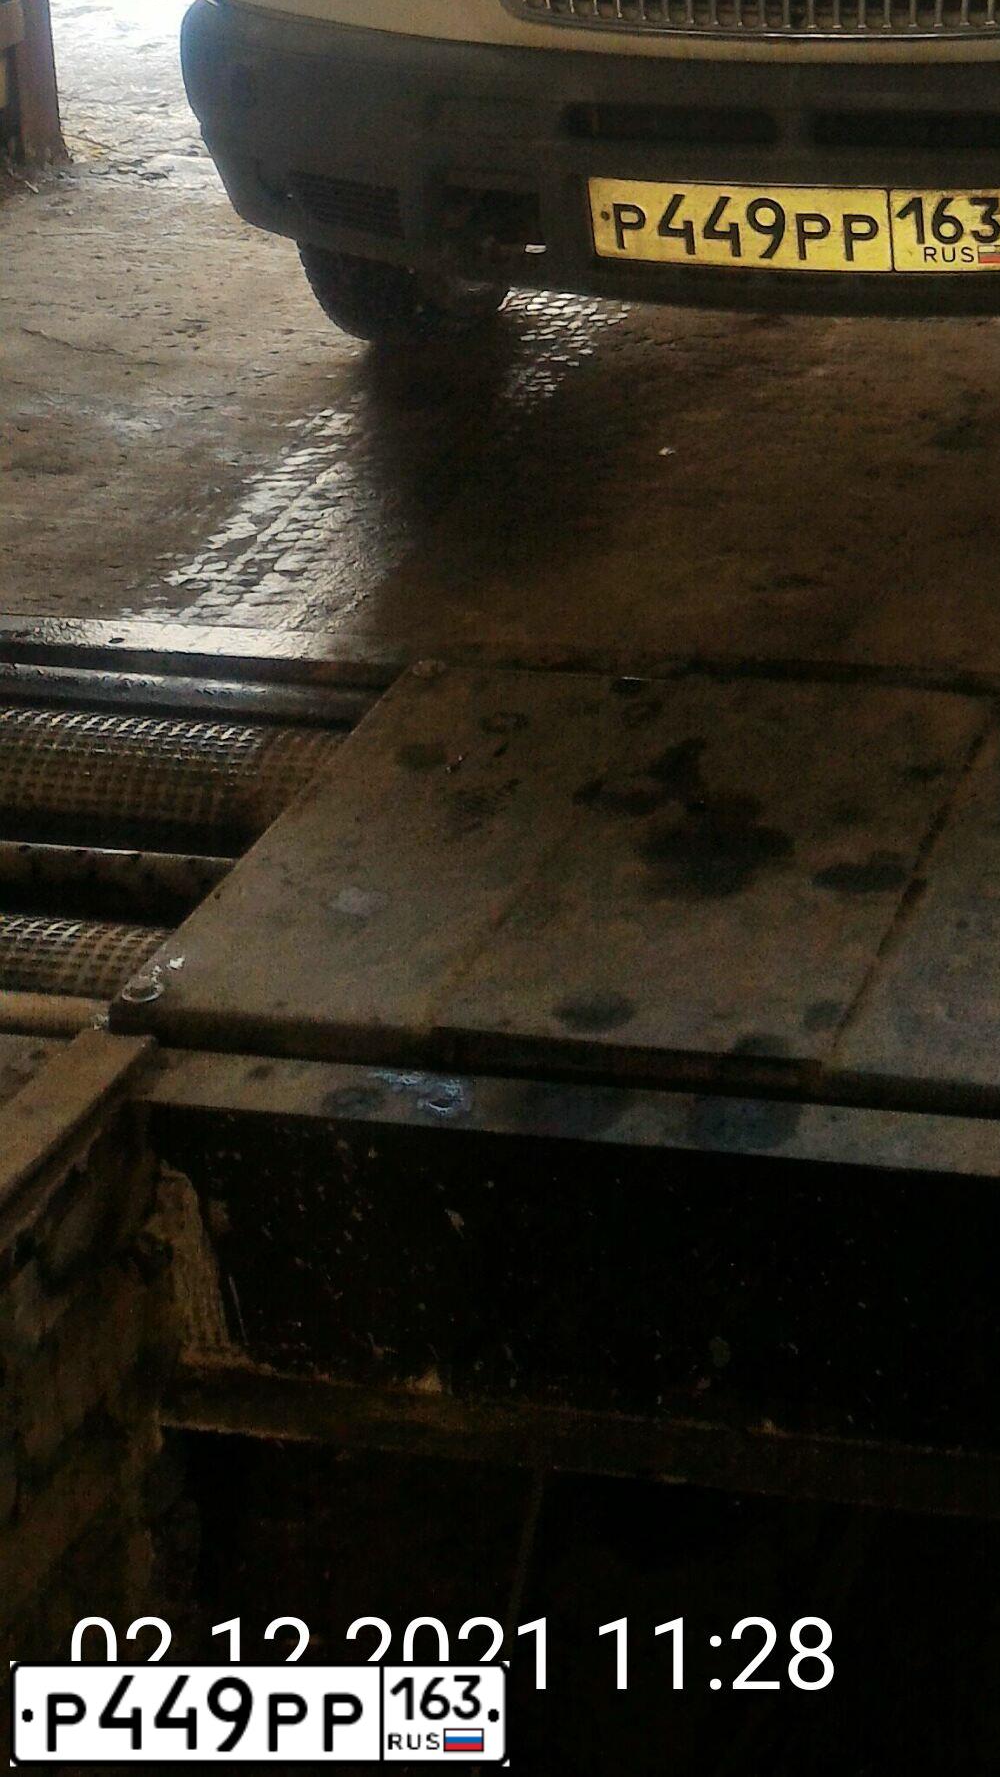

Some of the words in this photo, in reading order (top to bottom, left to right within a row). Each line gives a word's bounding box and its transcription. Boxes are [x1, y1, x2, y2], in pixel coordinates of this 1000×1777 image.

[612, 193, 879, 262] Р449РР
[896, 196, 1000, 245] 163
[924, 246, 975, 263] RUS
